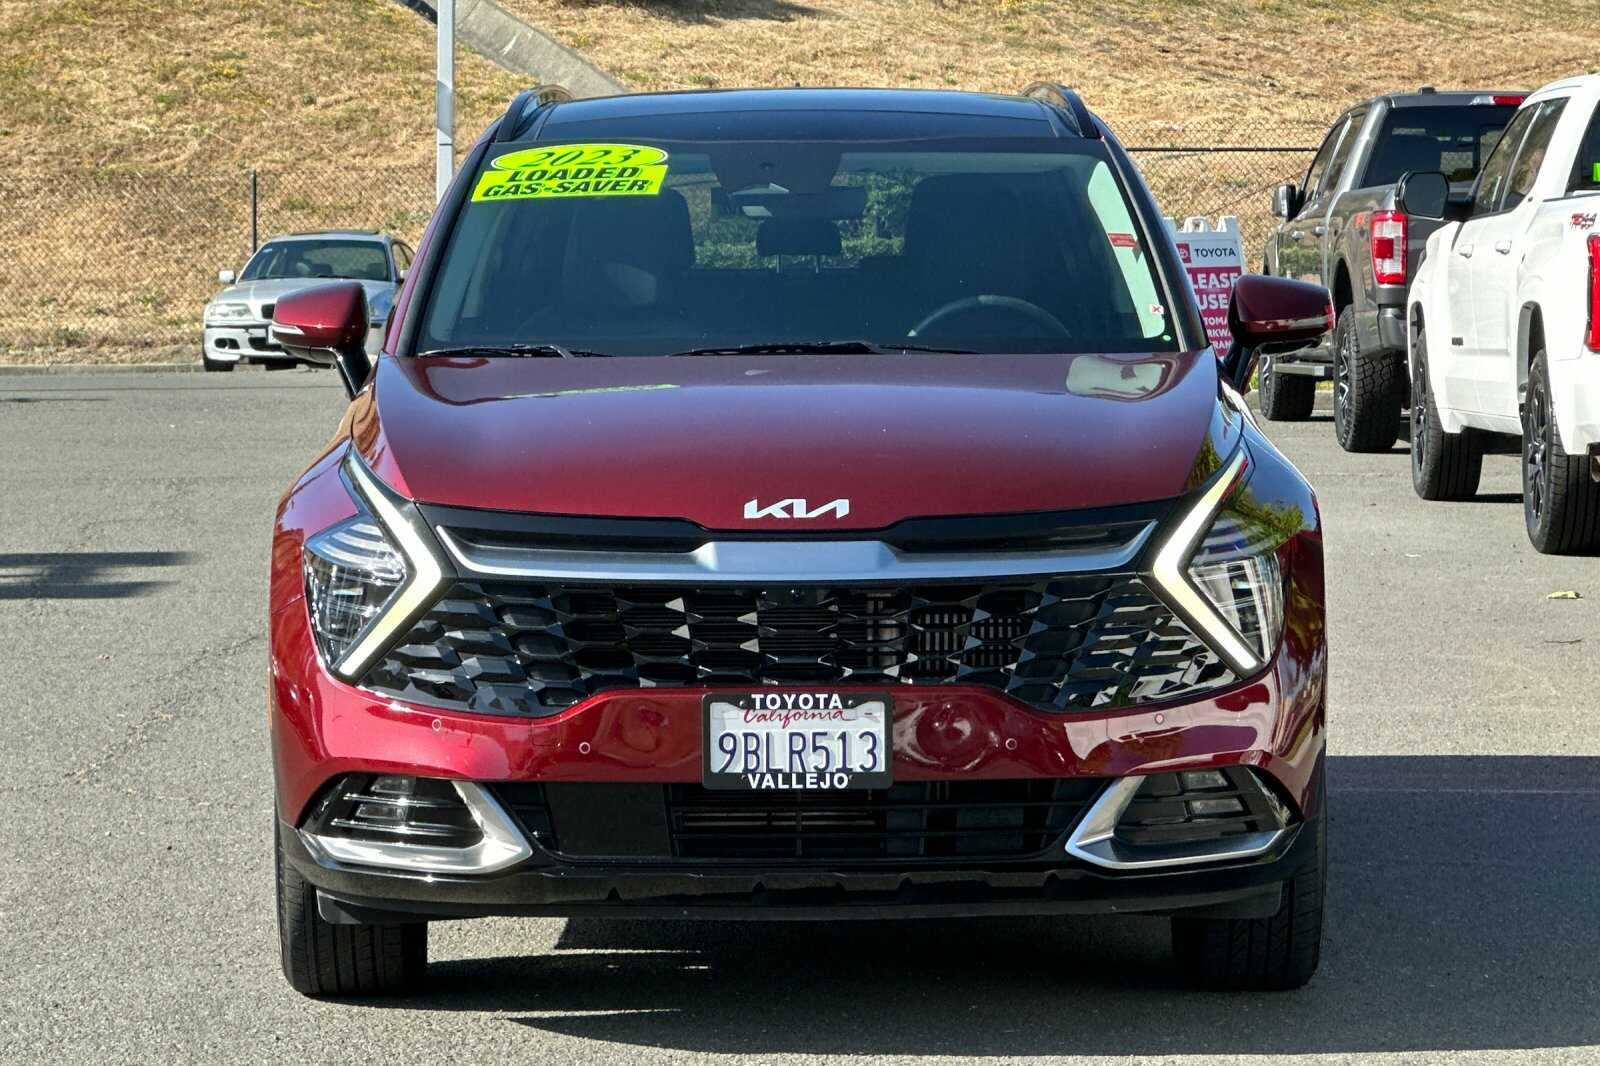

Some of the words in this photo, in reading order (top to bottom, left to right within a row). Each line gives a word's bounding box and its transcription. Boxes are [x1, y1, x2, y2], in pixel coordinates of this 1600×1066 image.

[520, 149, 641, 168] 2023
[507, 166, 642, 183] LOADED
[483, 180, 652, 198] GAS-SAVER
[1194, 247, 1237, 258] TOYOTA
[1191, 272, 1238, 289] LEASE
[1197, 293, 1229, 310] USE
[744, 498, 850, 519] KIA
[751, 694, 844, 710] TOYOTA
[743, 709, 856, 730] California
[718, 731, 878, 773] 9BLR513
[747, 773, 849, 790] VALLEJO
